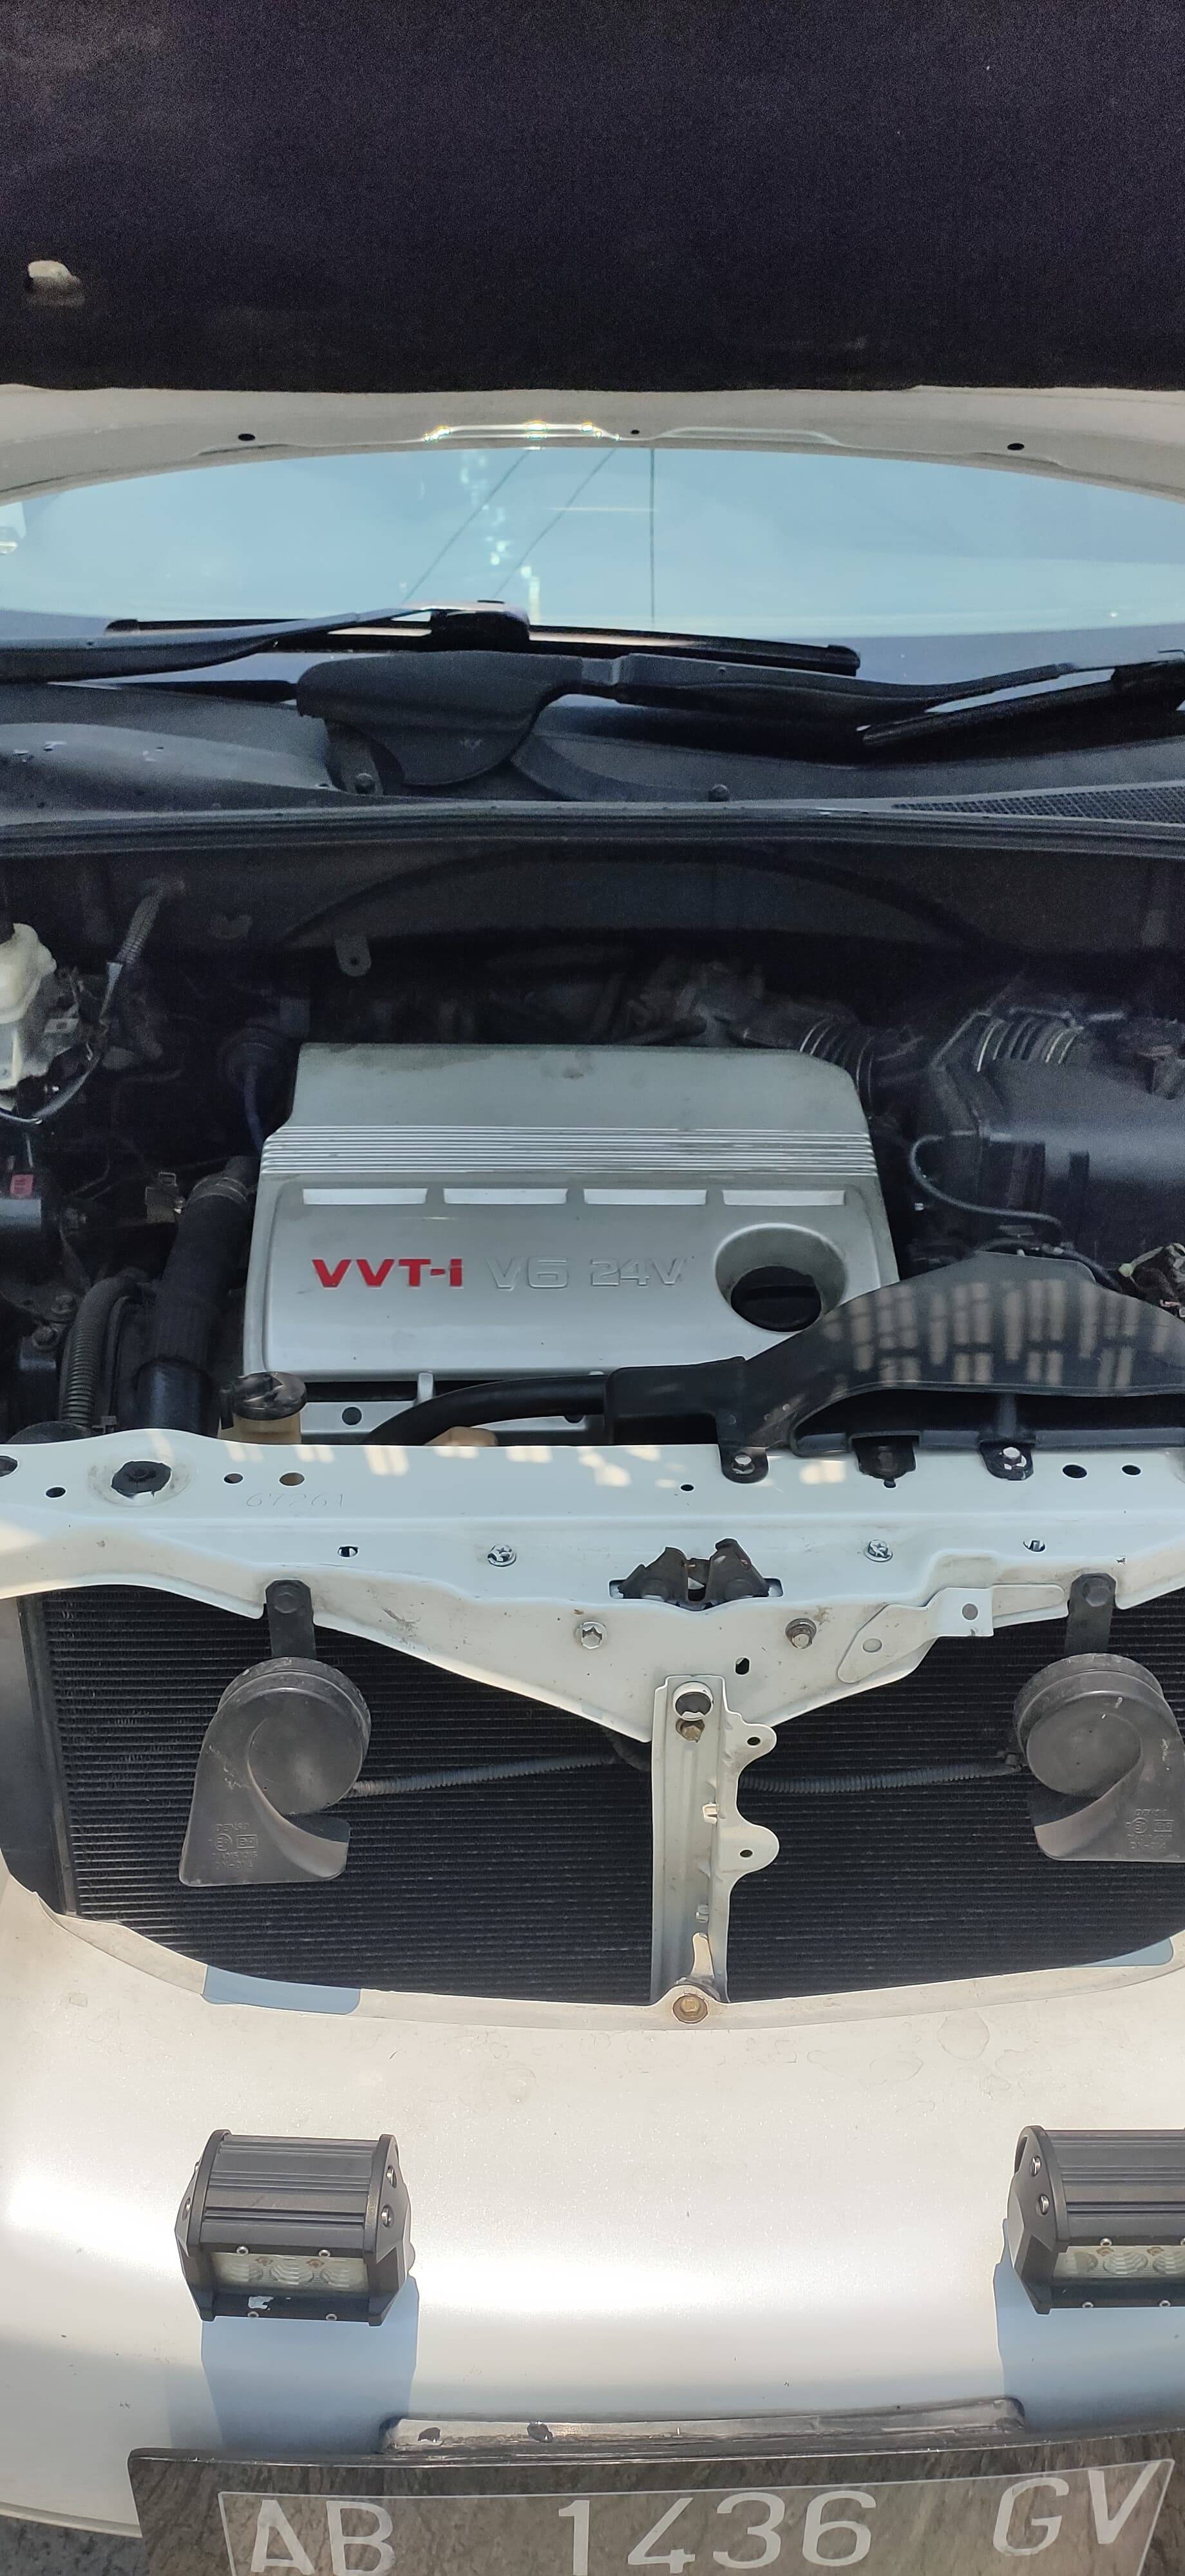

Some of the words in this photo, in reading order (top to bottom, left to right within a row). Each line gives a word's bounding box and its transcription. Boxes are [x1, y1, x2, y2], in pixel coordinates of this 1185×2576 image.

[486, 1256, 568, 1290] V6
[590, 1256, 685, 1286] 24V
[250, 2499, 395, 2576] AB
[558, 2490, 877, 2576] 1436
[992, 2460, 1160, 2556] GV
